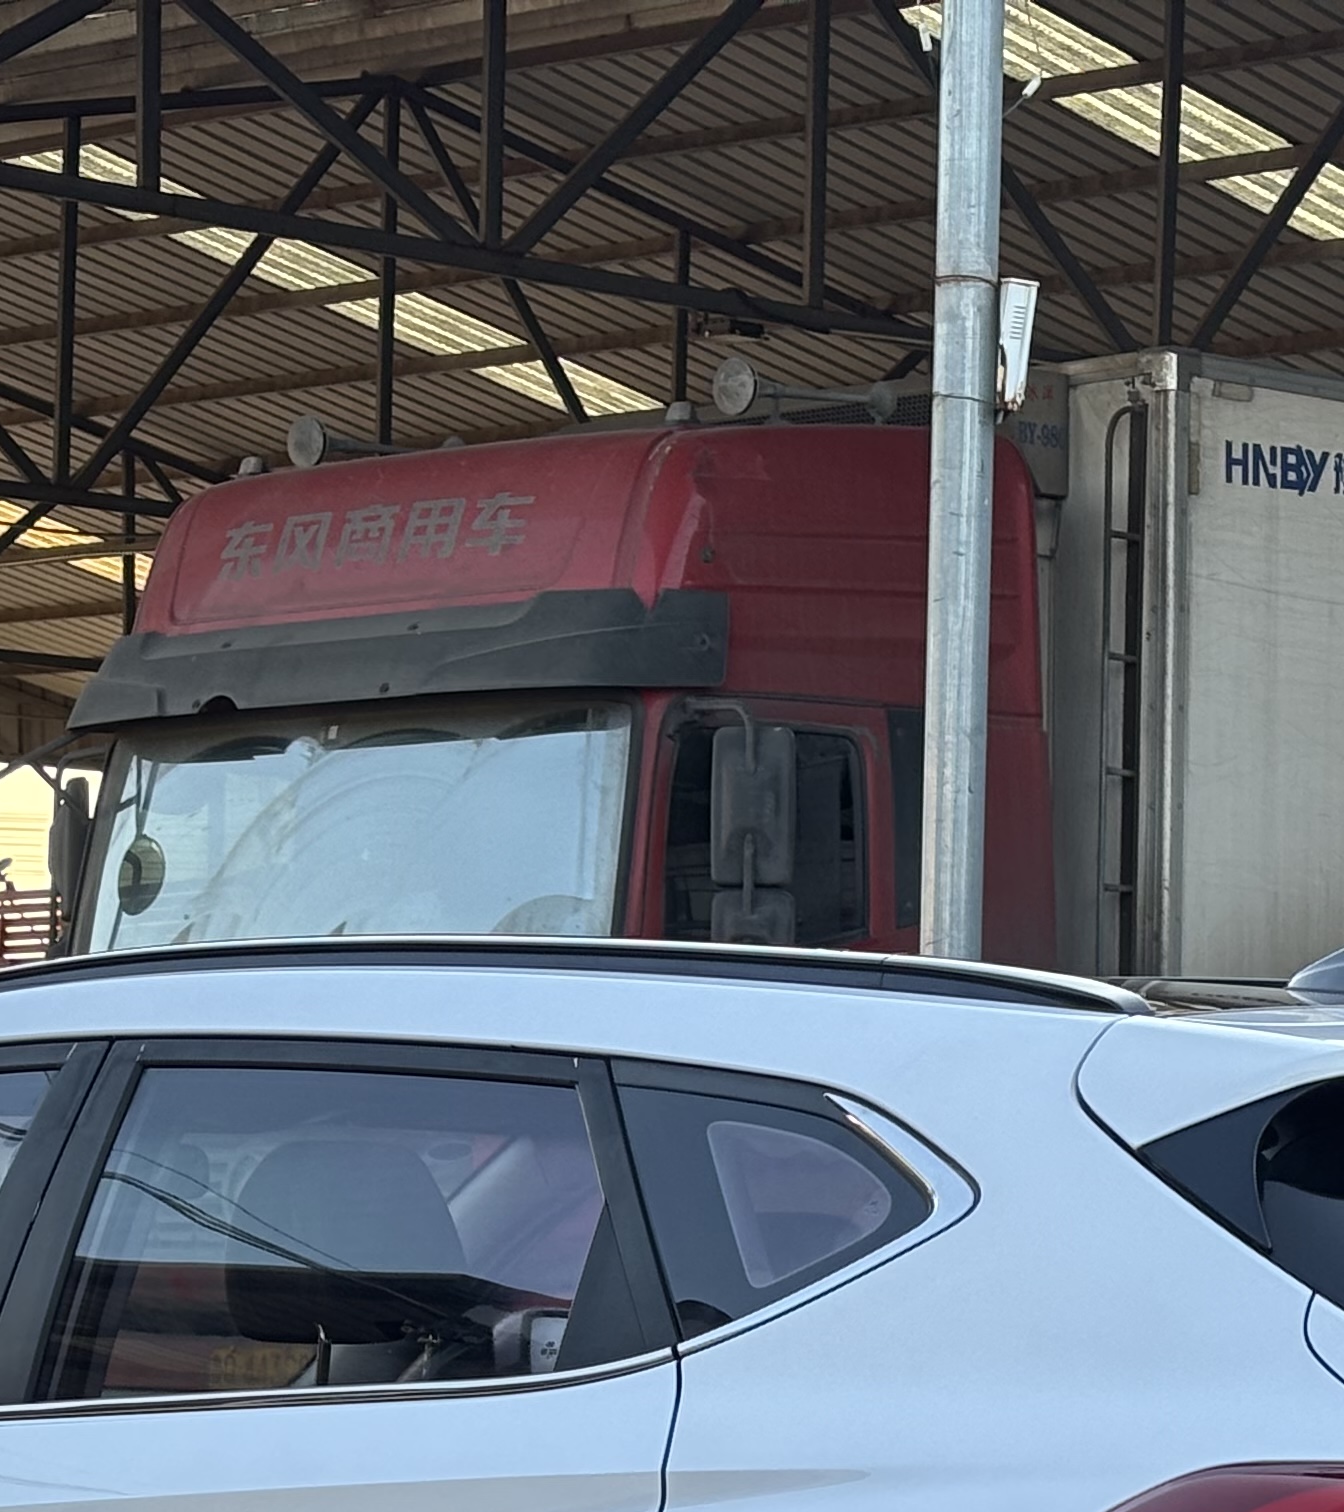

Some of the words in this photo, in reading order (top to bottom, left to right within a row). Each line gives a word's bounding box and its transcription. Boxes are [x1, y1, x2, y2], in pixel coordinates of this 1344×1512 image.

[1225, 439, 1330, 496] HNBY
[219, 492, 536, 582] 东风商用车
